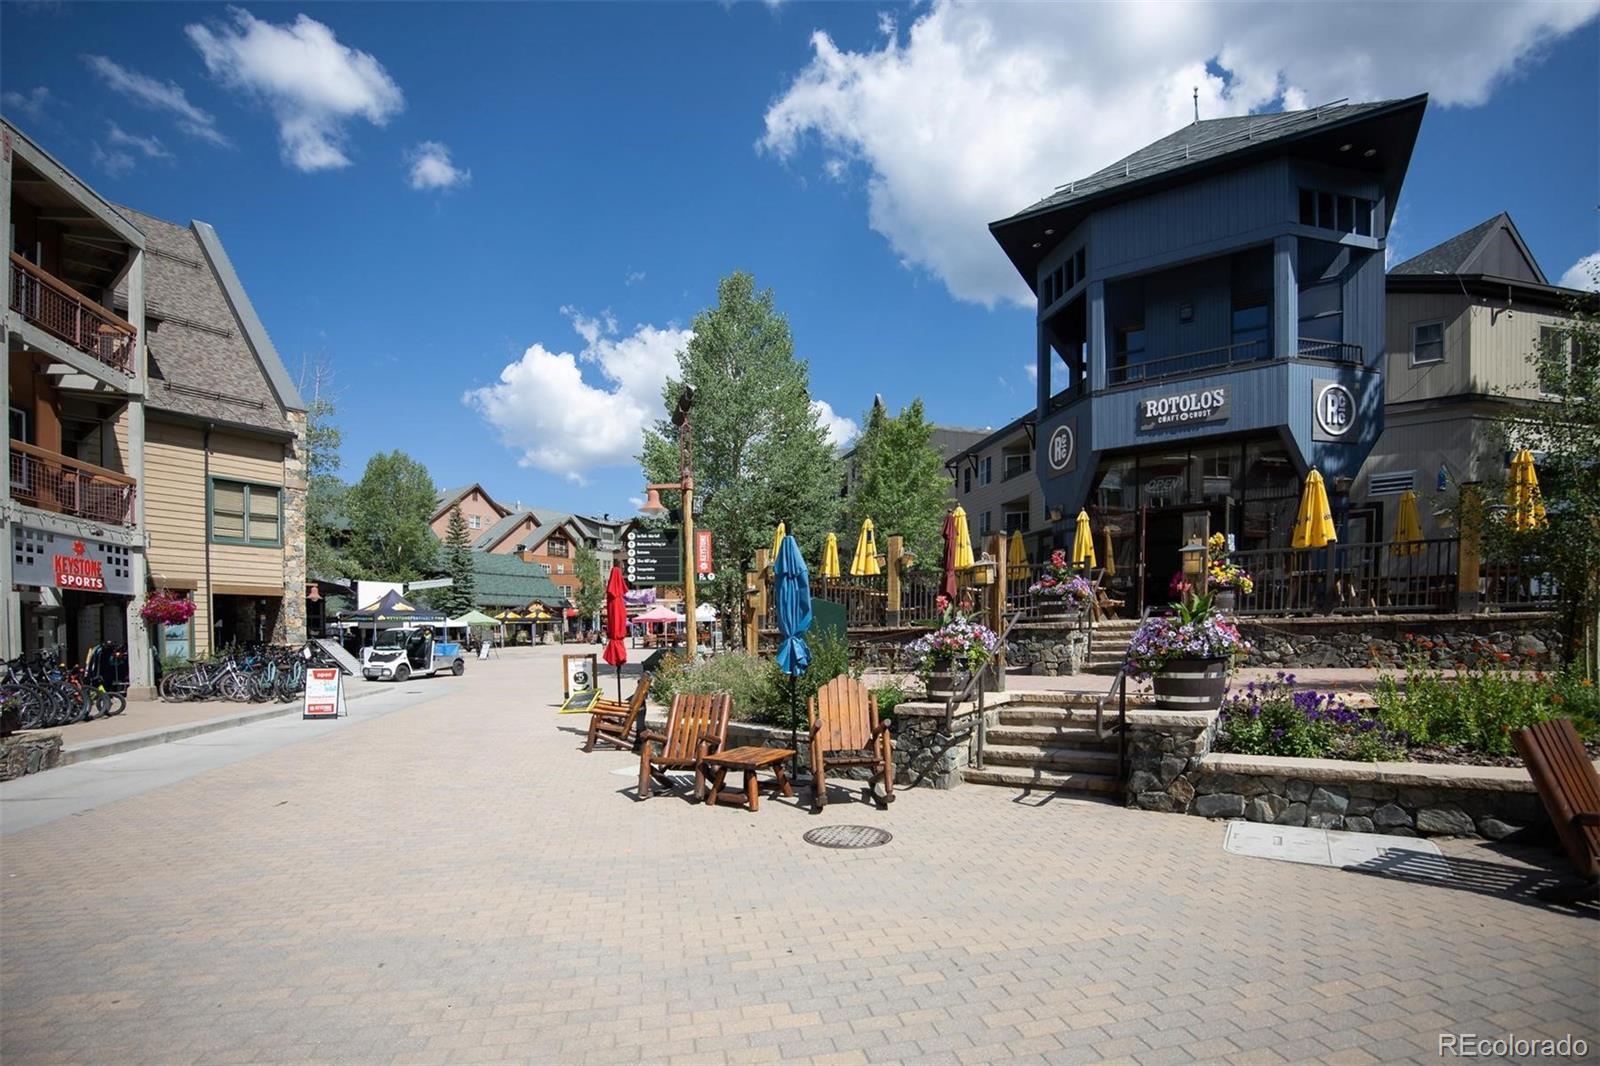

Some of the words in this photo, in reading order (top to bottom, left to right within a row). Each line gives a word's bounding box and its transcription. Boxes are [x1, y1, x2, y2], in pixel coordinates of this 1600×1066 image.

[1145, 389, 1225, 418] ROTOLO'S
[1157, 414, 1180, 424] CRAFT
[1188, 409, 1212, 420] CRUST
[54, 554, 103, 577] KEYSTONE
[60, 574, 103, 588] SPORTS
